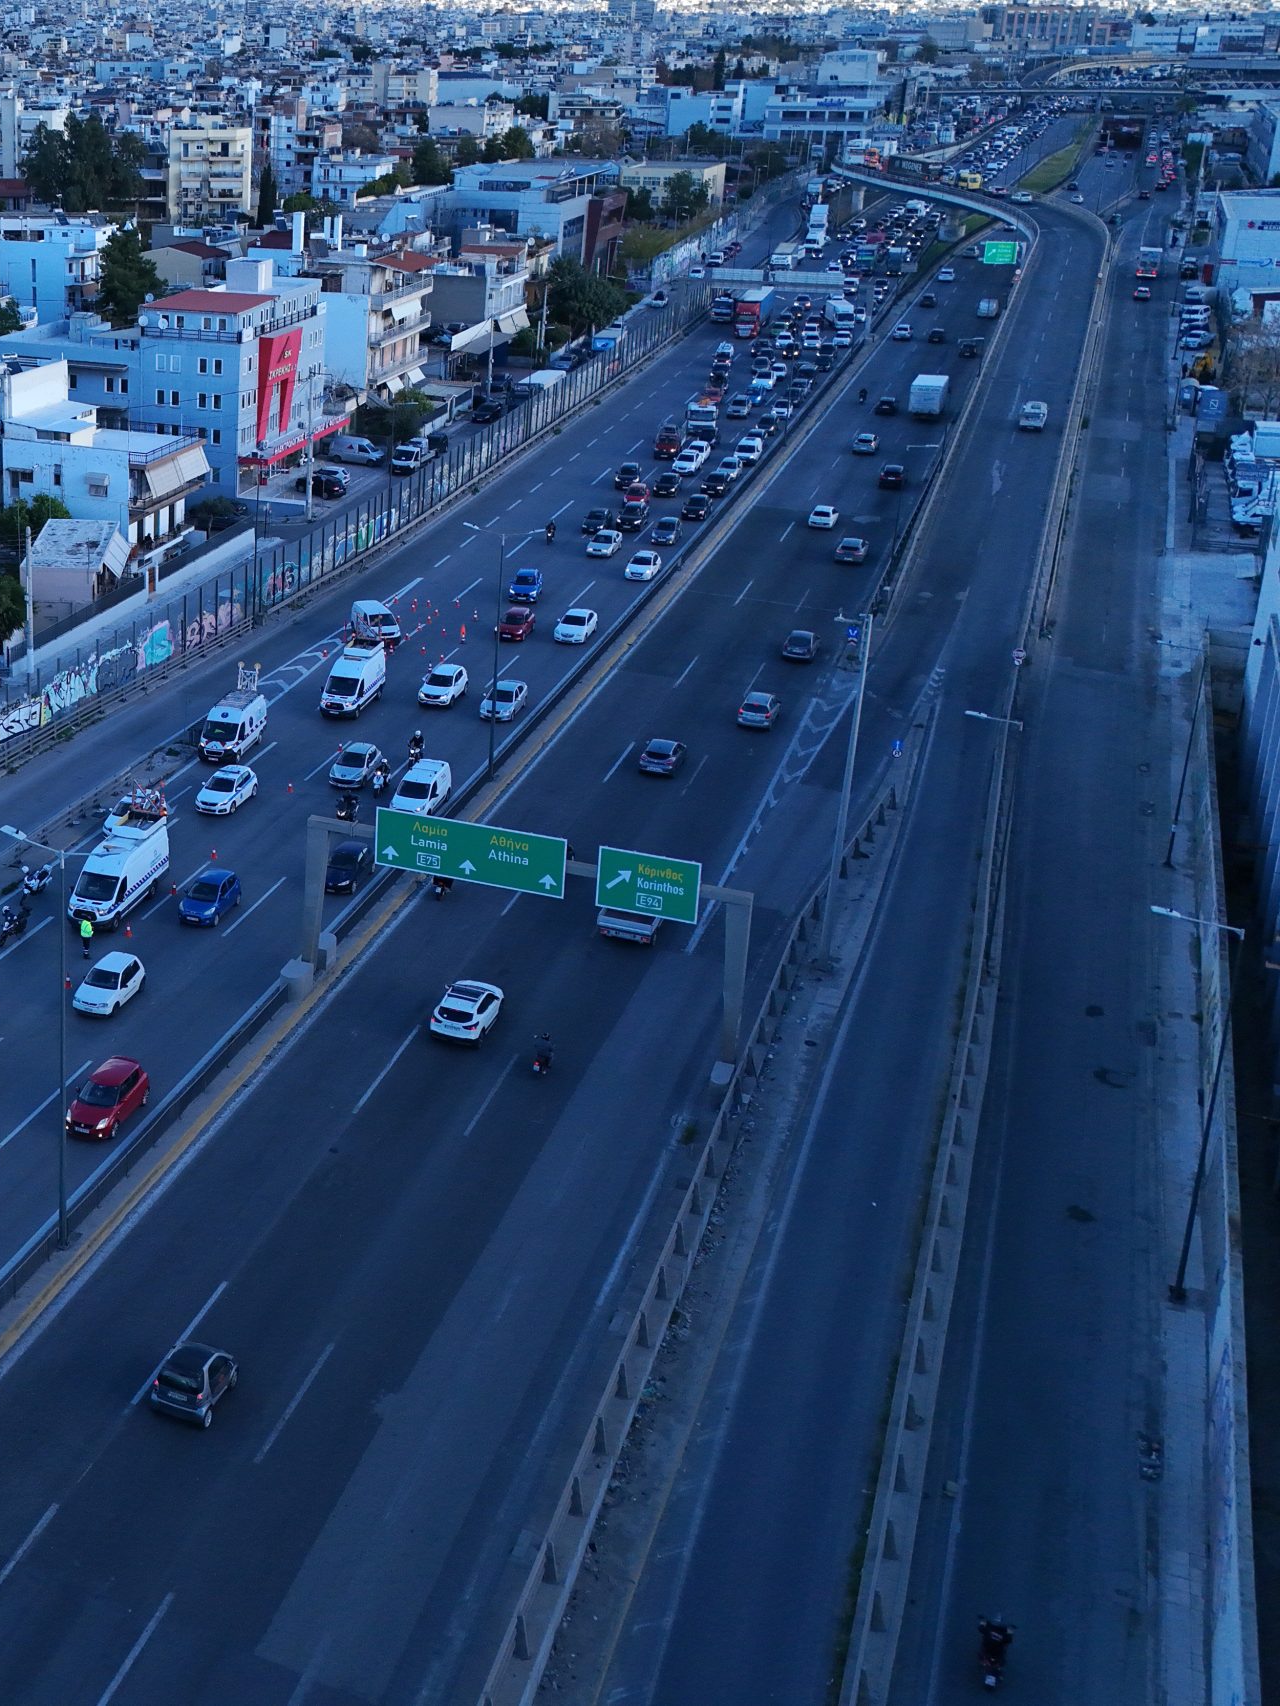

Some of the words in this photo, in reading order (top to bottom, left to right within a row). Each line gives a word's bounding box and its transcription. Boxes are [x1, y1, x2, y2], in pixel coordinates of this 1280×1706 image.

[412, 821, 448, 837] Λαμία
[410, 835, 448, 851] Lamia
[489, 835, 529, 851] Αθήνα
[419, 855, 438, 866] E75
[488, 849, 529, 866] Athina
[638, 863, 684, 883] Κόρινθος
[637, 877, 685, 896] Korinthos
[639, 895, 660, 907] E94
